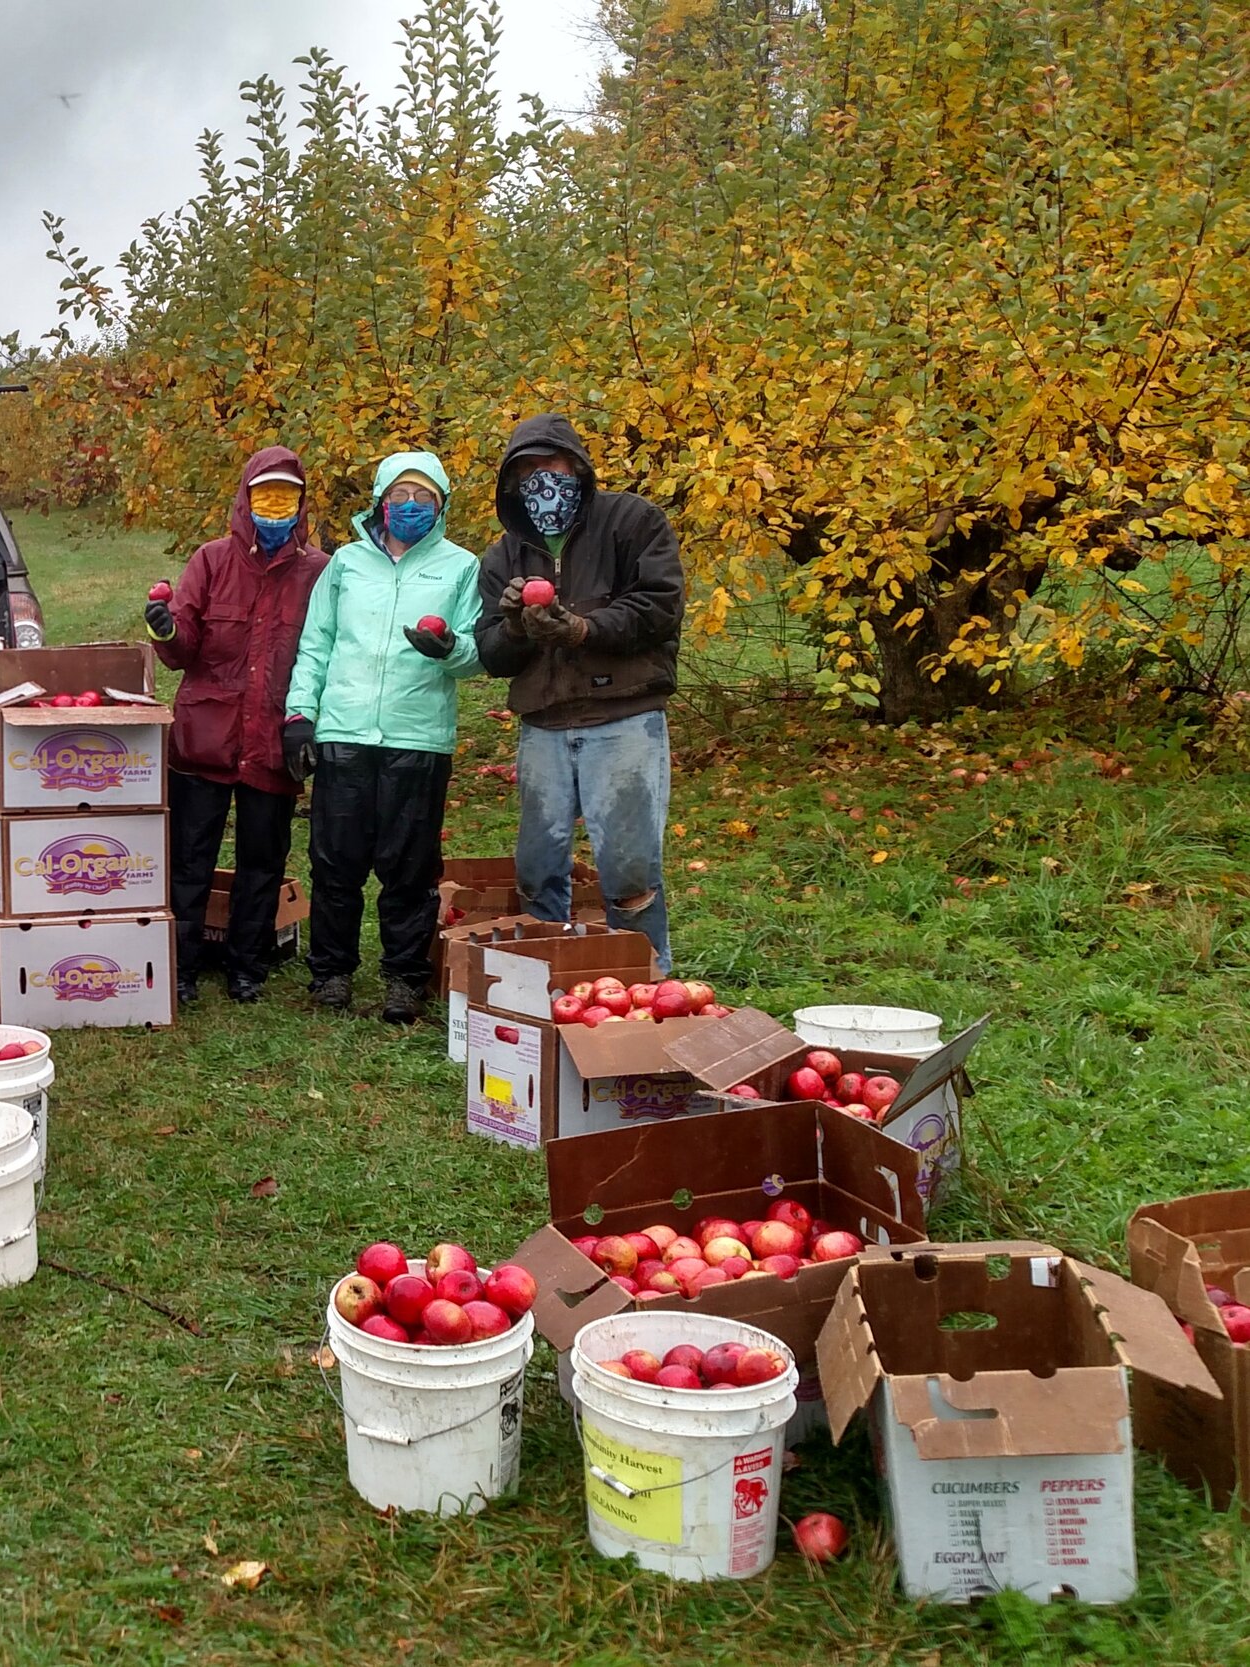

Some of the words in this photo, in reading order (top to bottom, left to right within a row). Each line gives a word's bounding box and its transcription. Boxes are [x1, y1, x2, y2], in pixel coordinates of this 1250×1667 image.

[8, 748, 152, 774] Cal-Organic
[14, 851, 155, 878] Cal-Organic
[30, 968, 142, 990] Cal-Organic
[619, 1453, 663, 1475] Harvest
[932, 1481, 1021, 1494] CUCUMBERS
[1040, 1478, 1106, 1492] PEPPERS
[591, 1490, 638, 1524] GLEANING
[934, 1551, 1007, 1564] EGGPLANT
